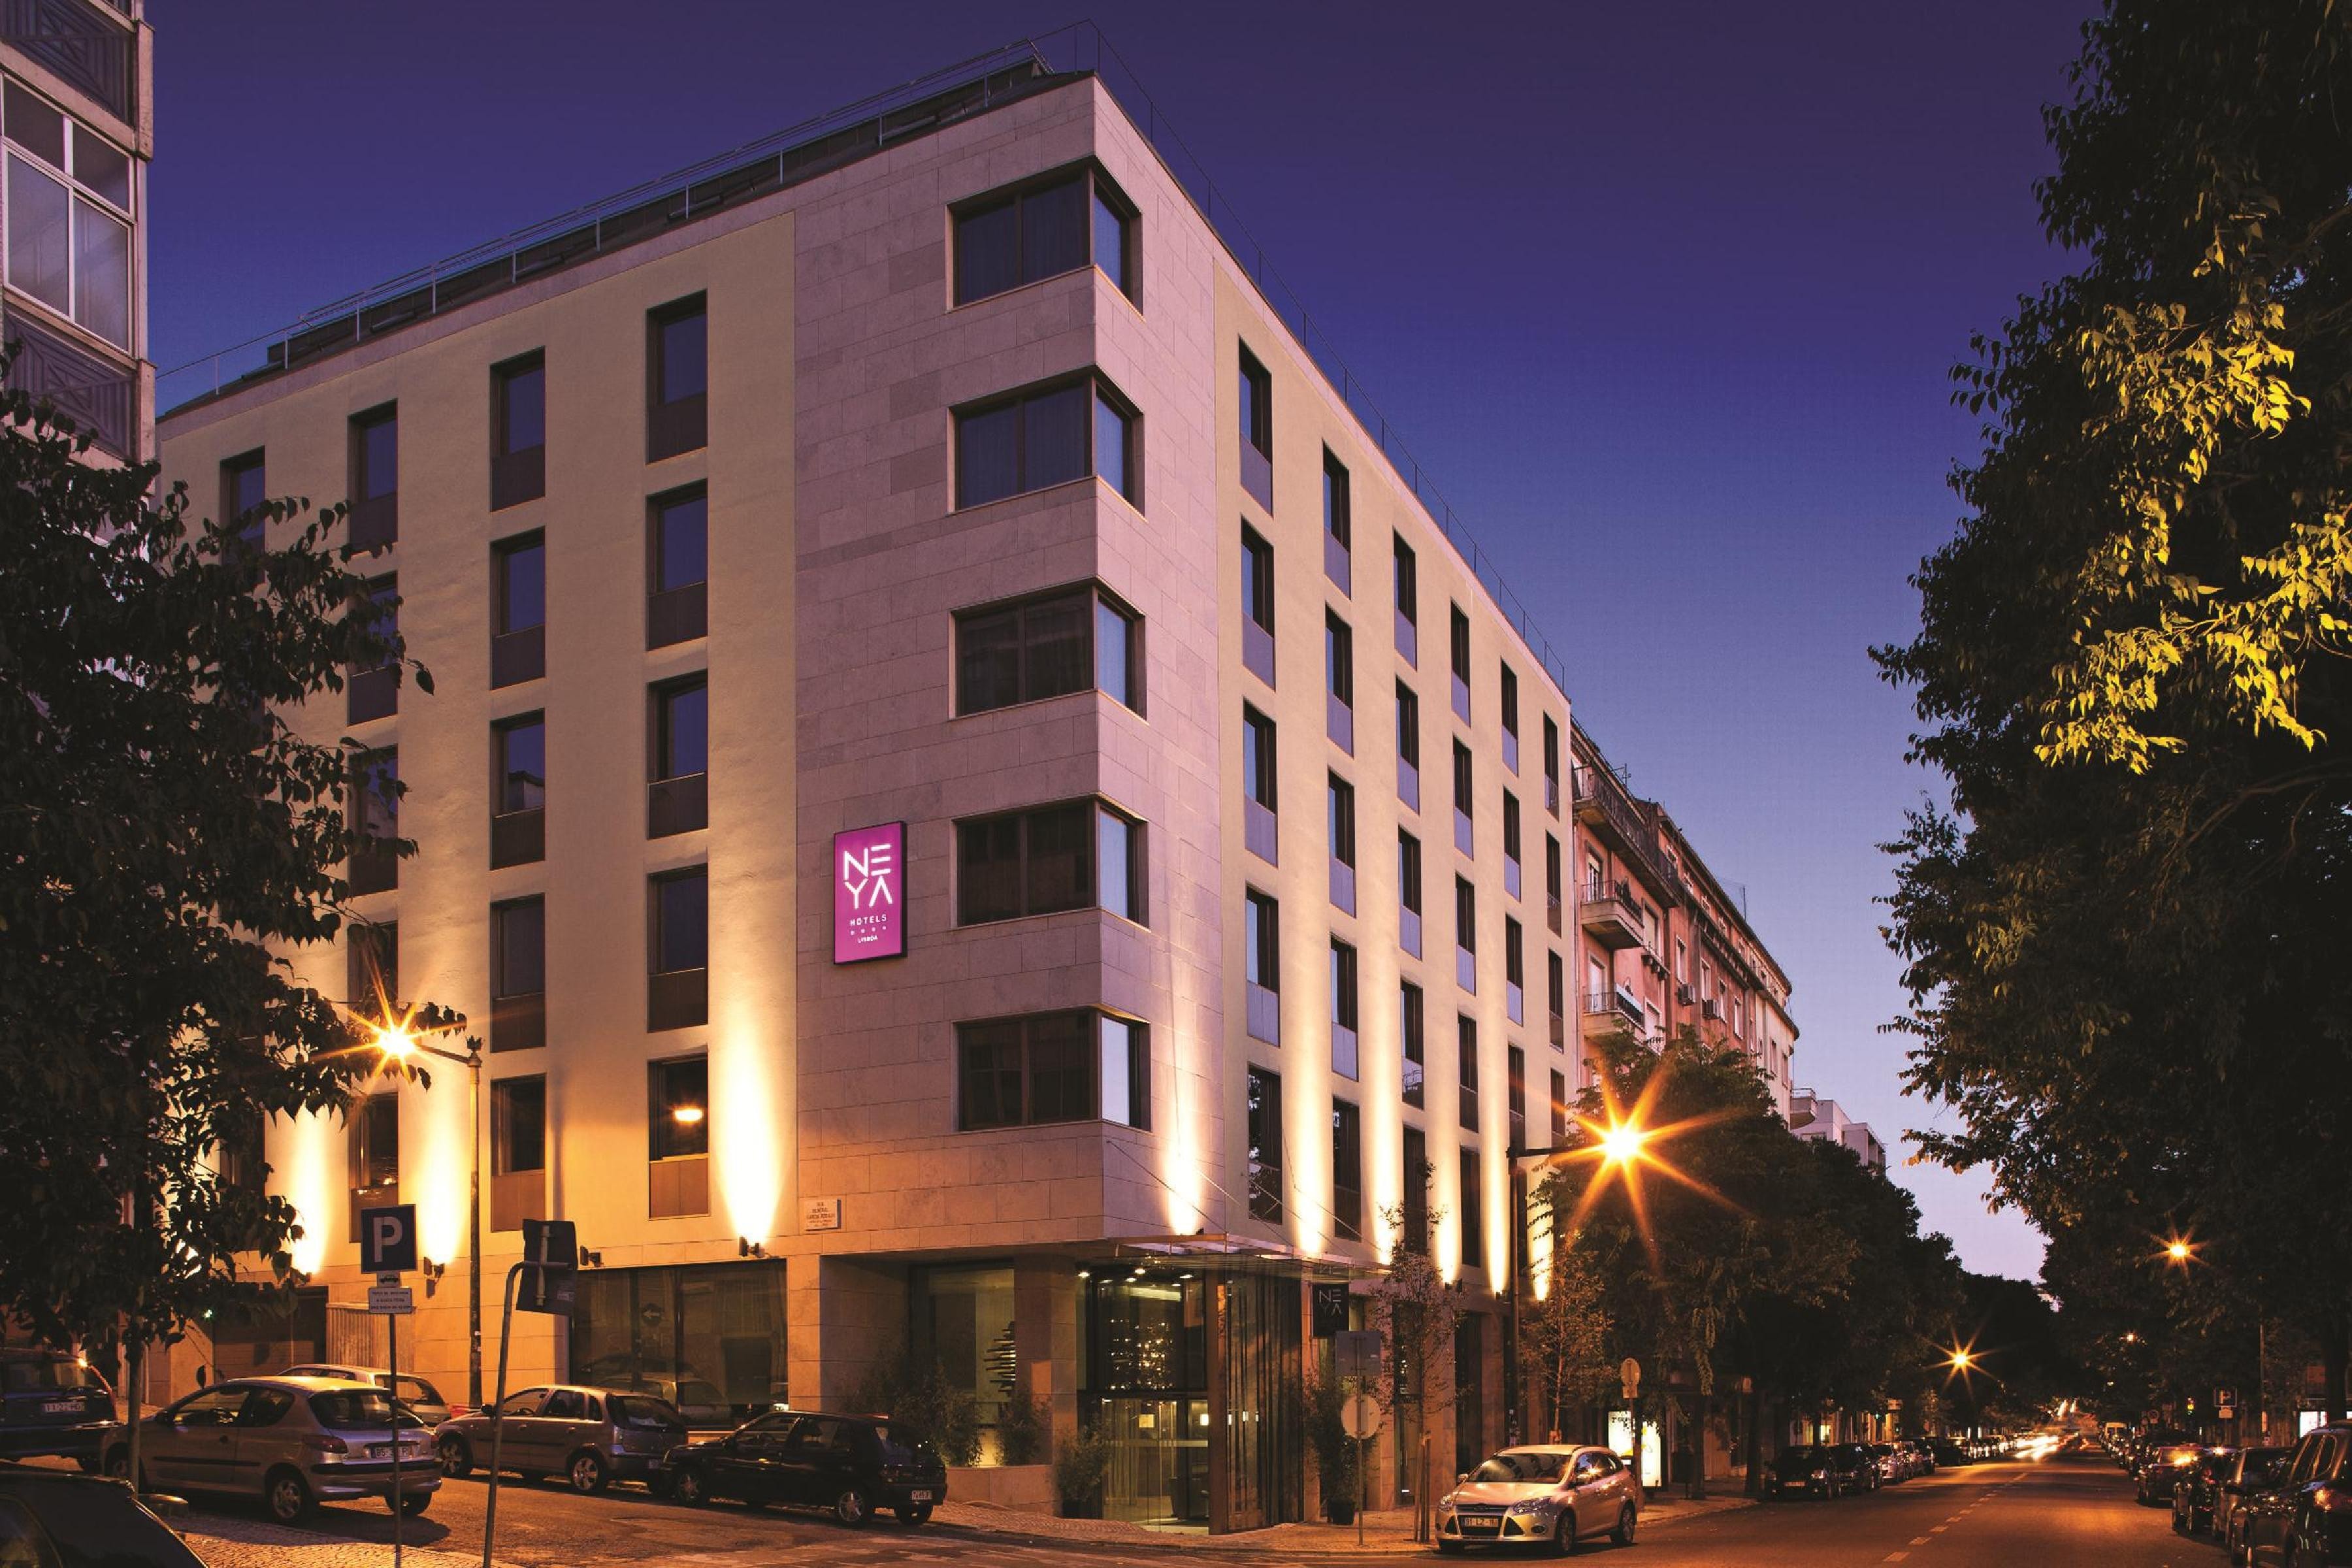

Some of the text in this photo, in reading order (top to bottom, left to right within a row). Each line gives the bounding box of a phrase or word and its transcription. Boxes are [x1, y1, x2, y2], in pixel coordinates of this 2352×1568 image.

[850, 914, 887, 926] HOTELS
[374, 1217, 402, 1263] P
[2219, 1390, 2231, 1404] P
